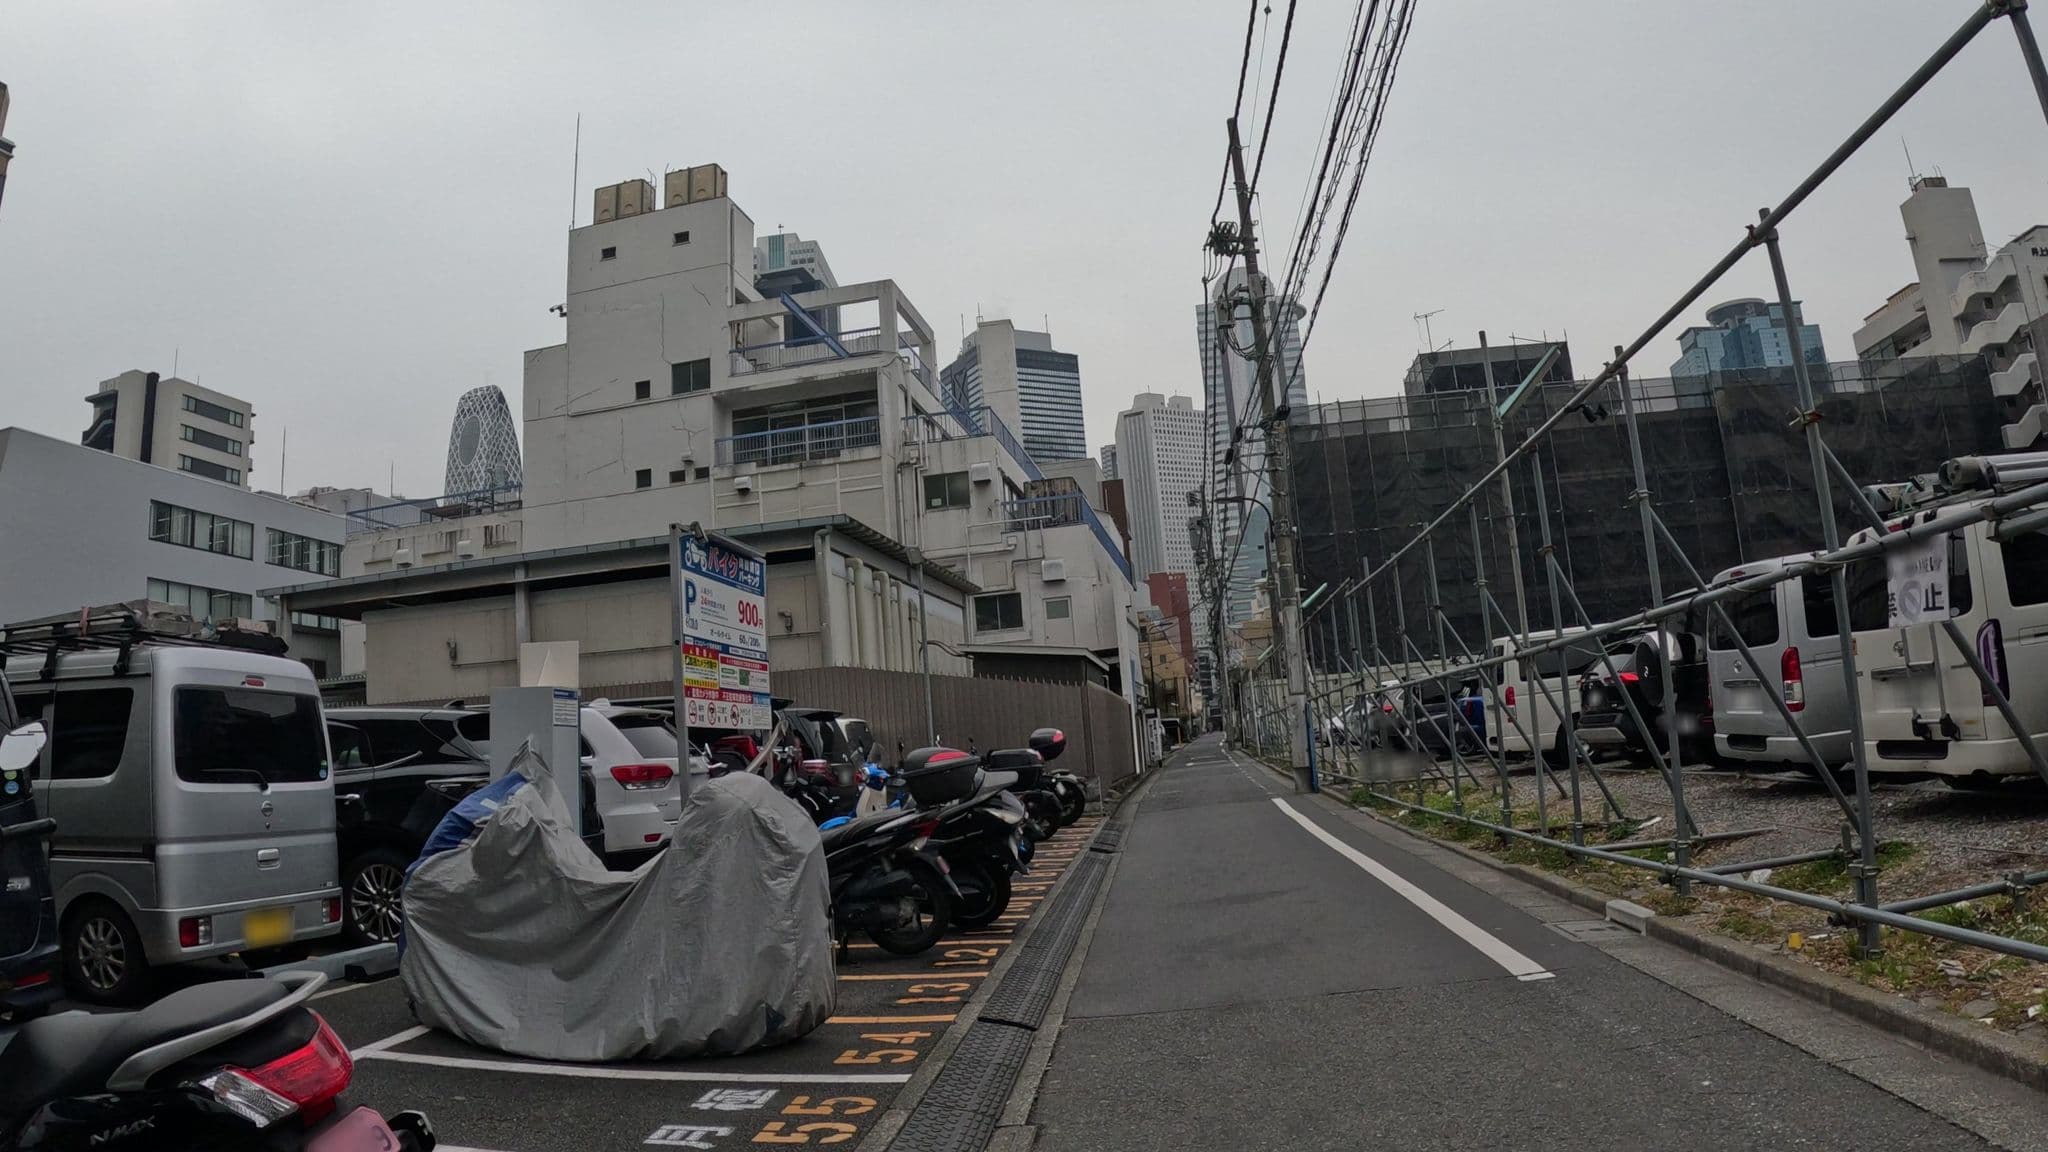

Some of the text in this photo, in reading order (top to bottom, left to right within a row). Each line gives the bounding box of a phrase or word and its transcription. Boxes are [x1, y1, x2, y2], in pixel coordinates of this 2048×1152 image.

[708, 546, 738, 577] バイク
[685, 579, 696, 615] P
[896, 982, 971, 1005] 13
[833, 1029, 933, 1065] 54
[752, 1095, 878, 1145] 55
